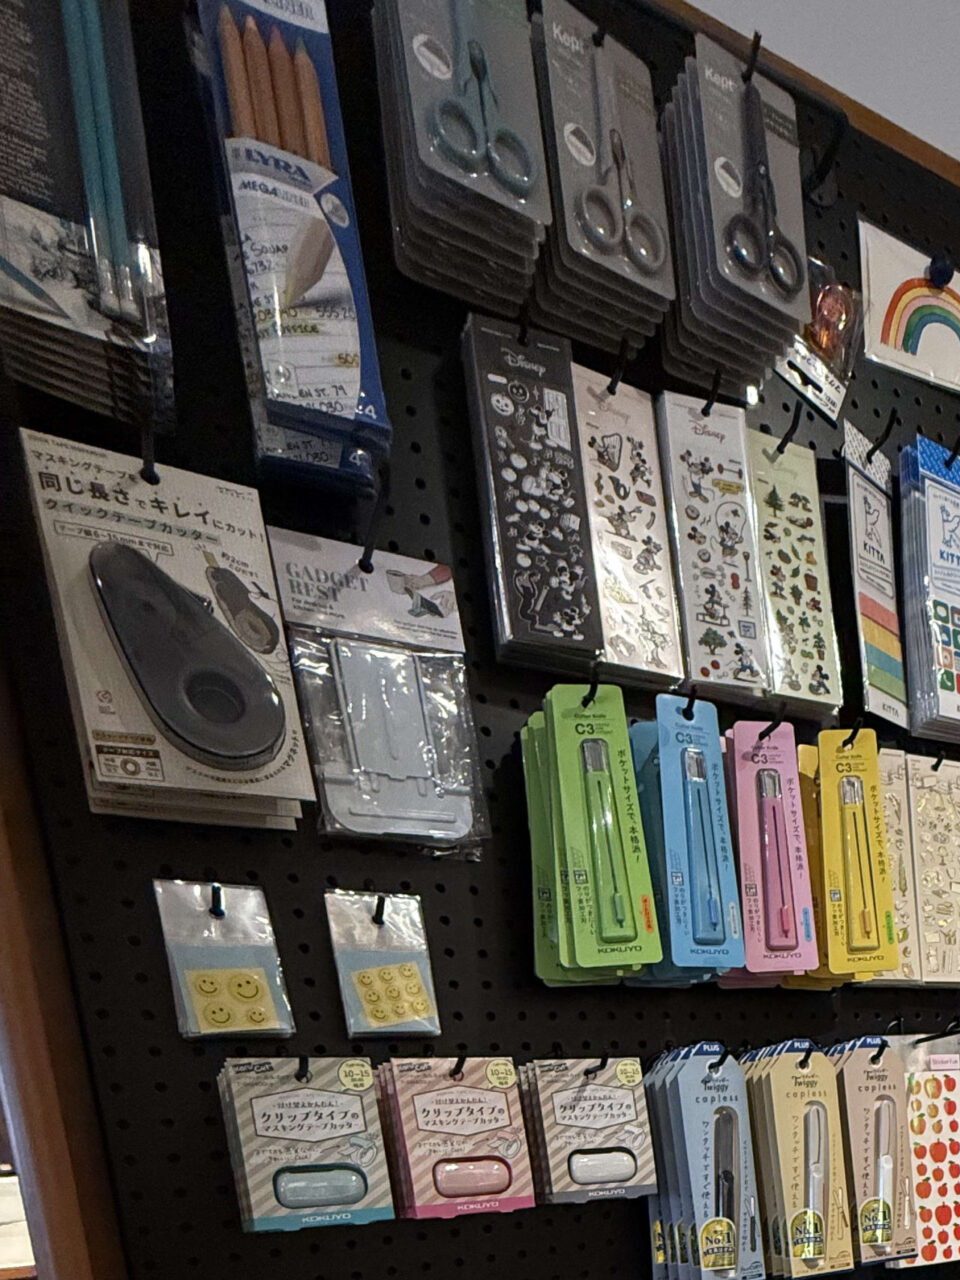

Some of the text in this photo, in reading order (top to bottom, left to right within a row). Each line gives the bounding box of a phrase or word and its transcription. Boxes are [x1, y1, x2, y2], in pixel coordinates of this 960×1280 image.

[244, 147, 312, 183] LYRA
[239, 180, 278, 197] MEGA
[502, 350, 546, 377] Disney
[690, 419, 727, 443] Disney
[45, 497, 219, 544] クイックテープカッター
[863, 541, 886, 565] KITTA
[285, 562, 370, 593] GADGET
[288, 579, 342, 602] REST
[882, 703, 899, 718] KITTA
[575, 722, 595, 735] C3
[675, 732, 693, 744] C3
[751, 753, 769, 764] C3
[835, 762, 852, 773] C3
[597, 945, 643, 954] KOKUYO
[690, 948, 729, 956] KOKUYO
[847, 954, 885, 962] KOKUYO
[794, 1041, 809, 1049] PLUS
[866, 1037, 882, 1045] PLUS
[702, 1043, 720, 1052] PLUS
[863, 1069, 889, 1082] Twiggy
[701, 1078, 729, 1093] Twiggy
[791, 1075, 818, 1088] Twiggy
[858, 1083, 897, 1092] capless
[695, 1094, 739, 1104] capless
[786, 1089, 827, 1098] capless
[421, 1107, 505, 1118] クリップタイプの
[559, 1103, 632, 1113] クリップタイプの
[261, 1109, 359, 1123] クリップタイプの
[588, 1188, 626, 1197] KOKUYO
[457, 1201, 499, 1211] KOKUYO
[301, 1213, 352, 1223] KOKUYO
[705, 1231, 732, 1245] No.1
